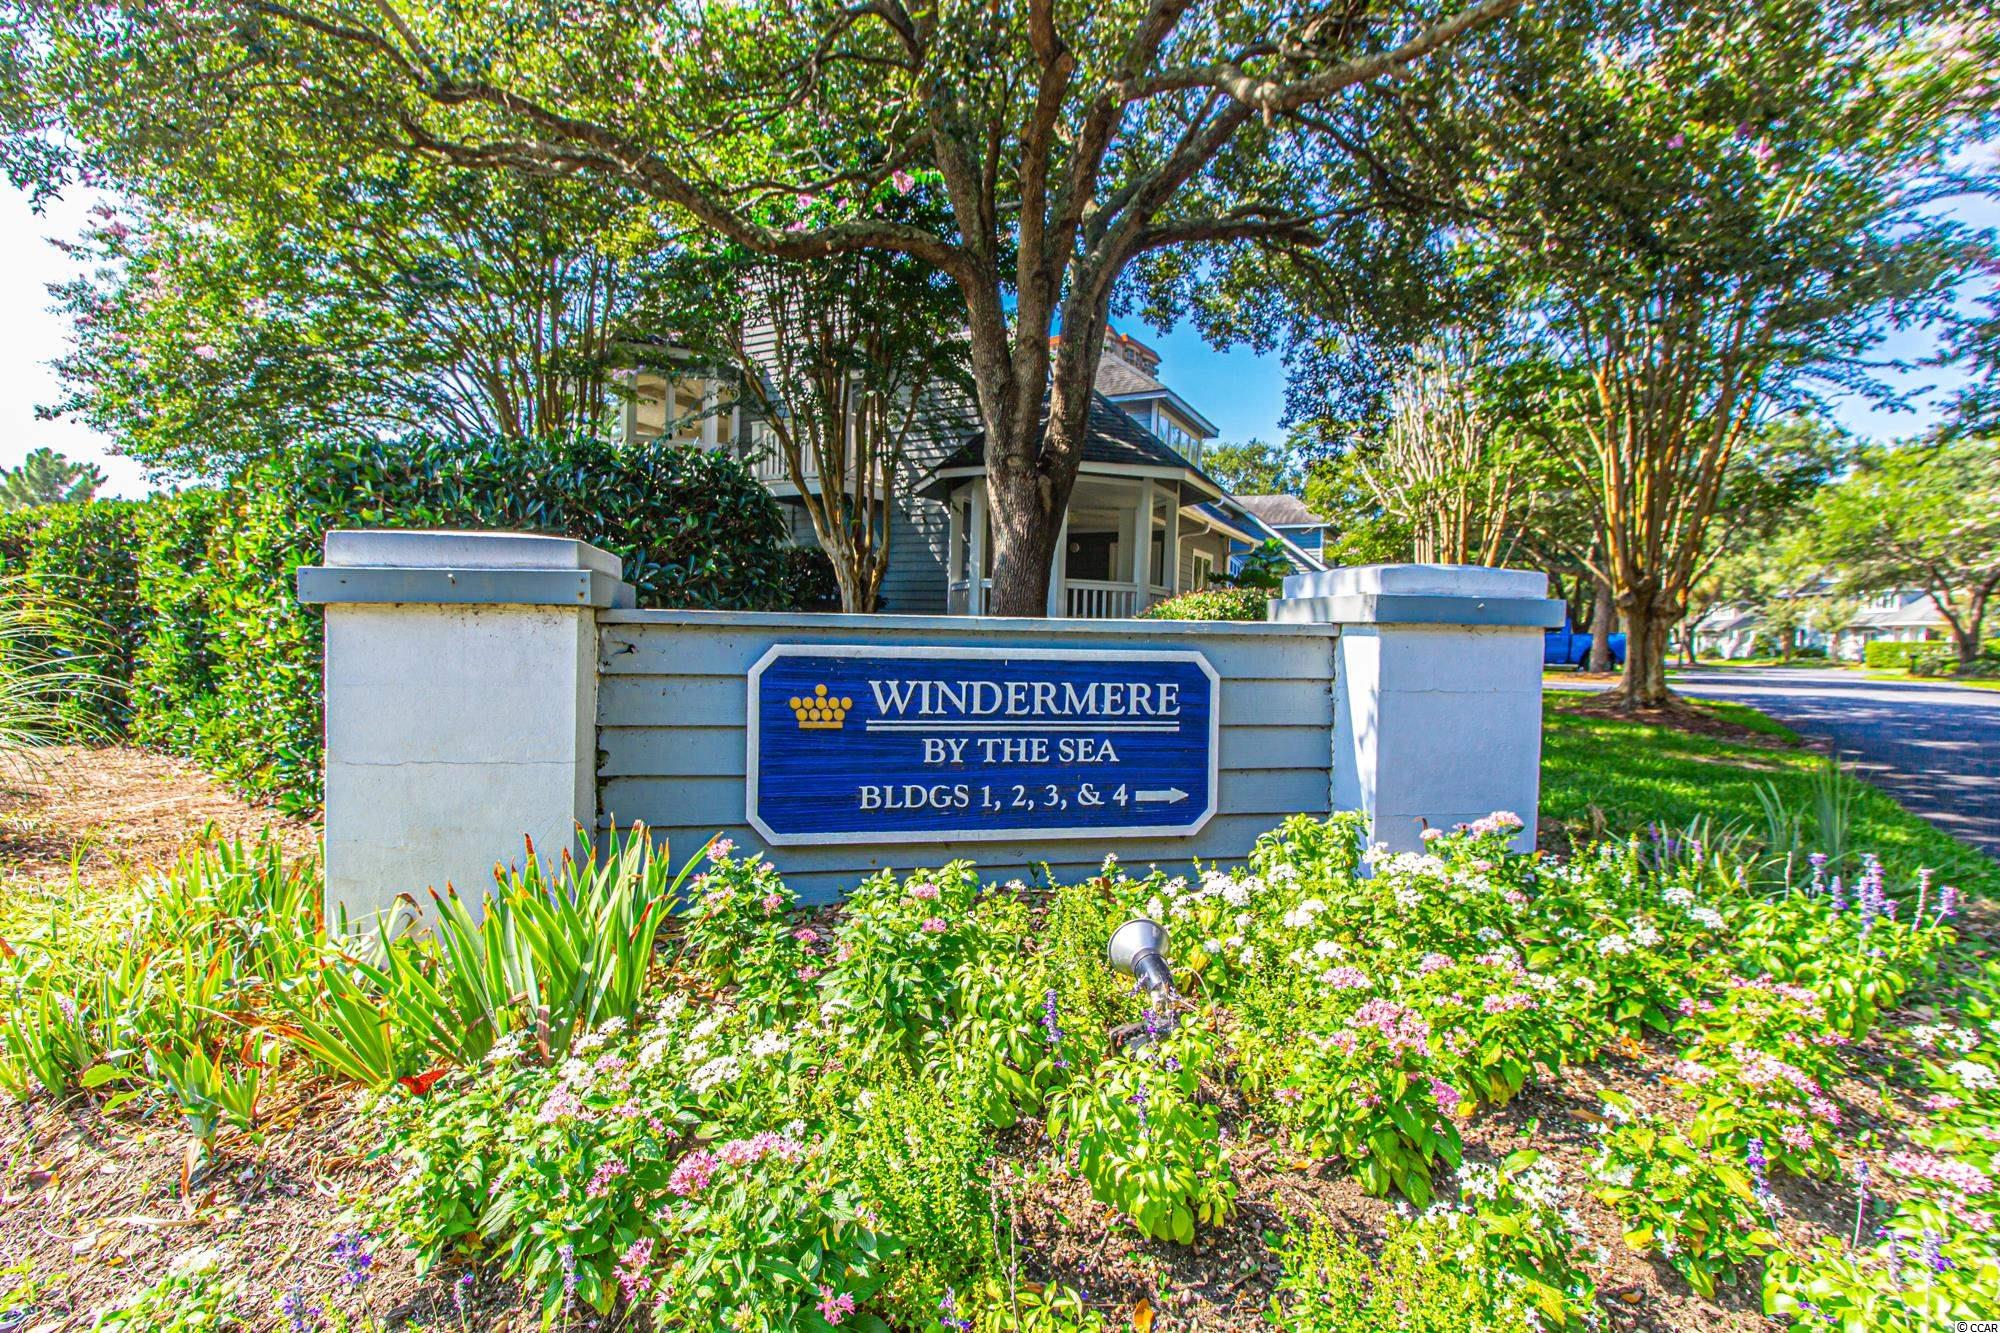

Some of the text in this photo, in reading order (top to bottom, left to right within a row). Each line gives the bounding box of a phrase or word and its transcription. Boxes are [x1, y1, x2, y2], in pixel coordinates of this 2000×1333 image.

[869, 680, 1181, 716] WINDERMERE
[923, 738, 1120, 763] BY THE SEA
[859, 784, 1128, 810] BLDGS 1, 2, 3, & 4
